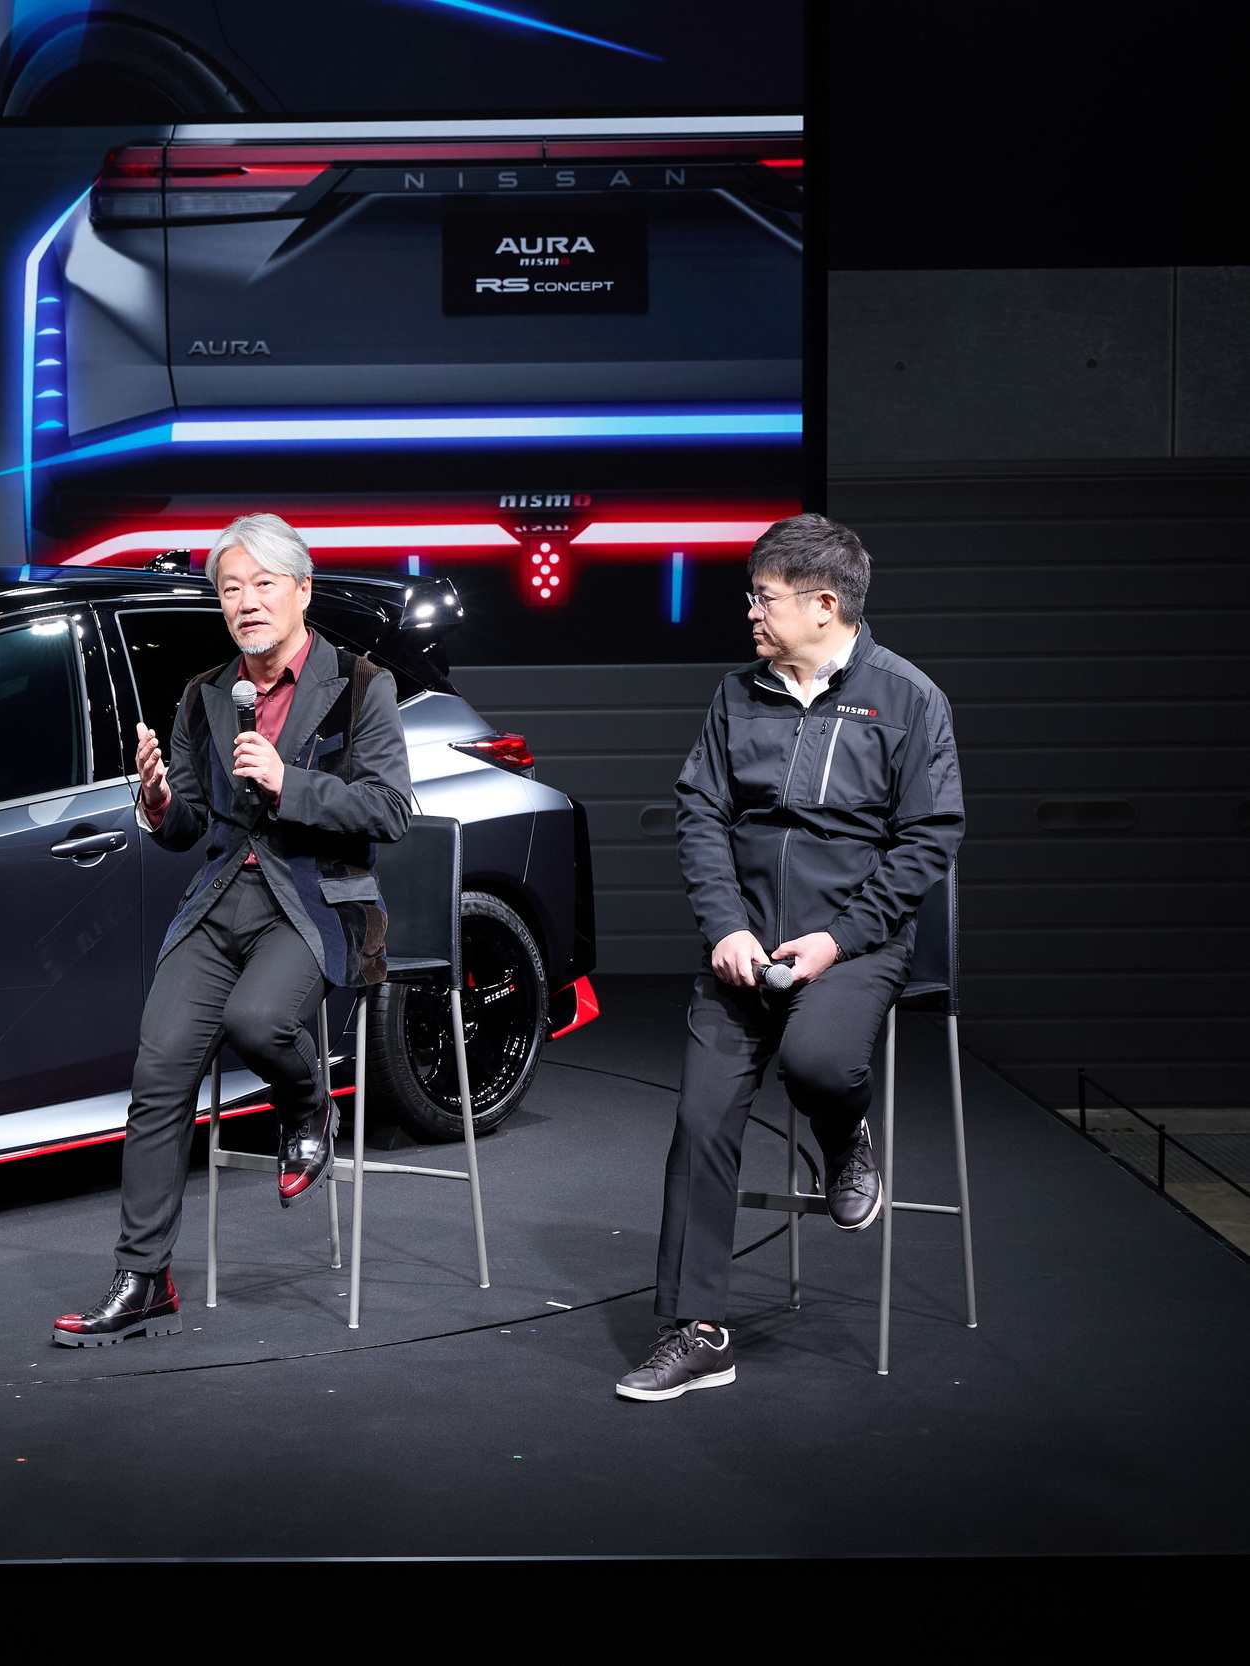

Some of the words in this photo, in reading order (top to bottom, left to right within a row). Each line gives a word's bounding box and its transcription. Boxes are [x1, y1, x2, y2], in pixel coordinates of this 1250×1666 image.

[405, 169, 685, 189] NISSAN
[495, 236, 595, 254] AURA
[519, 257, 571, 266] nismo
[475, 278, 530, 293] RS
[533, 281, 614, 292] CONCEPT
[188, 340, 271, 356] AURA
[499, 493, 591, 508] nismo
[836, 704, 877, 716] nismo
[518, 928, 544, 979] MICHELIN
